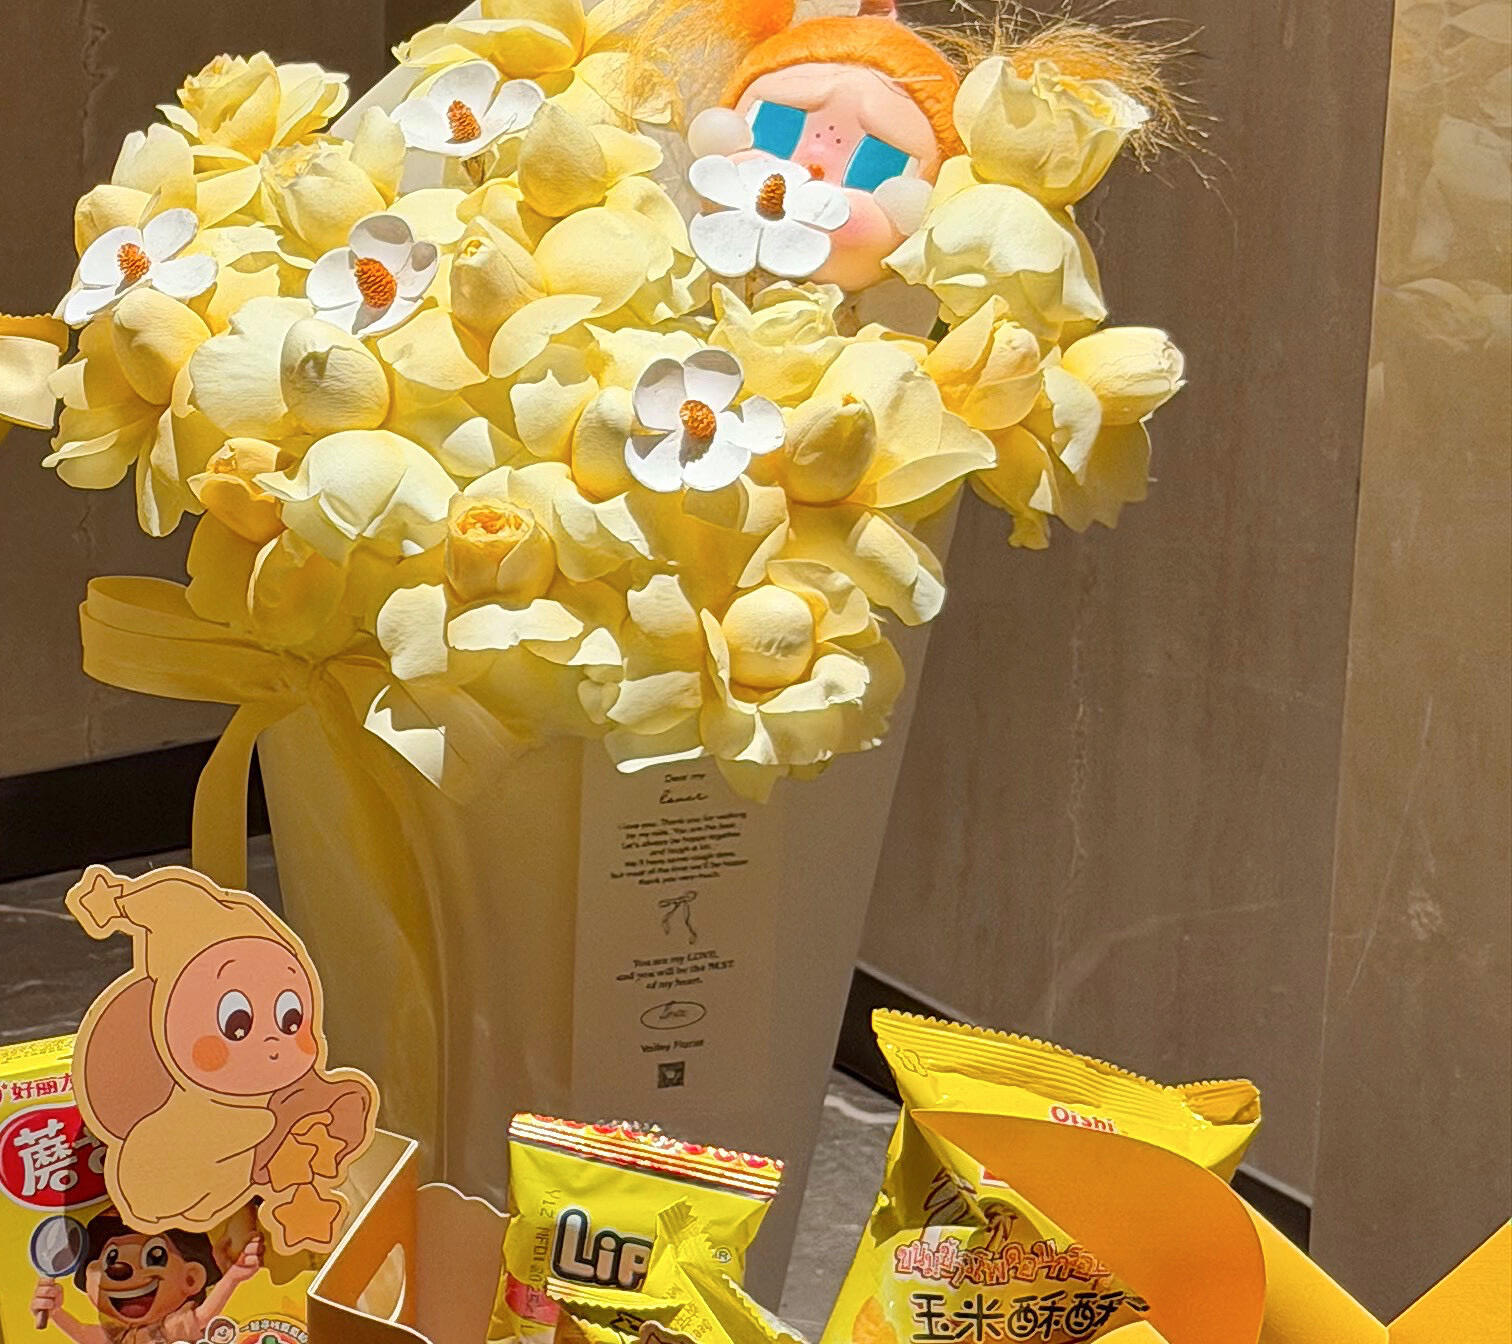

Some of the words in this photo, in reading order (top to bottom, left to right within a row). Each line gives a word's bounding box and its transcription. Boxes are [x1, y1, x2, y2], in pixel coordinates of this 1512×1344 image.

[1051, 1105, 1117, 1134] Oishi
[552, 1206, 656, 1291] LiP
[910, 1290, 1152, 1343] 玉米酥酥
